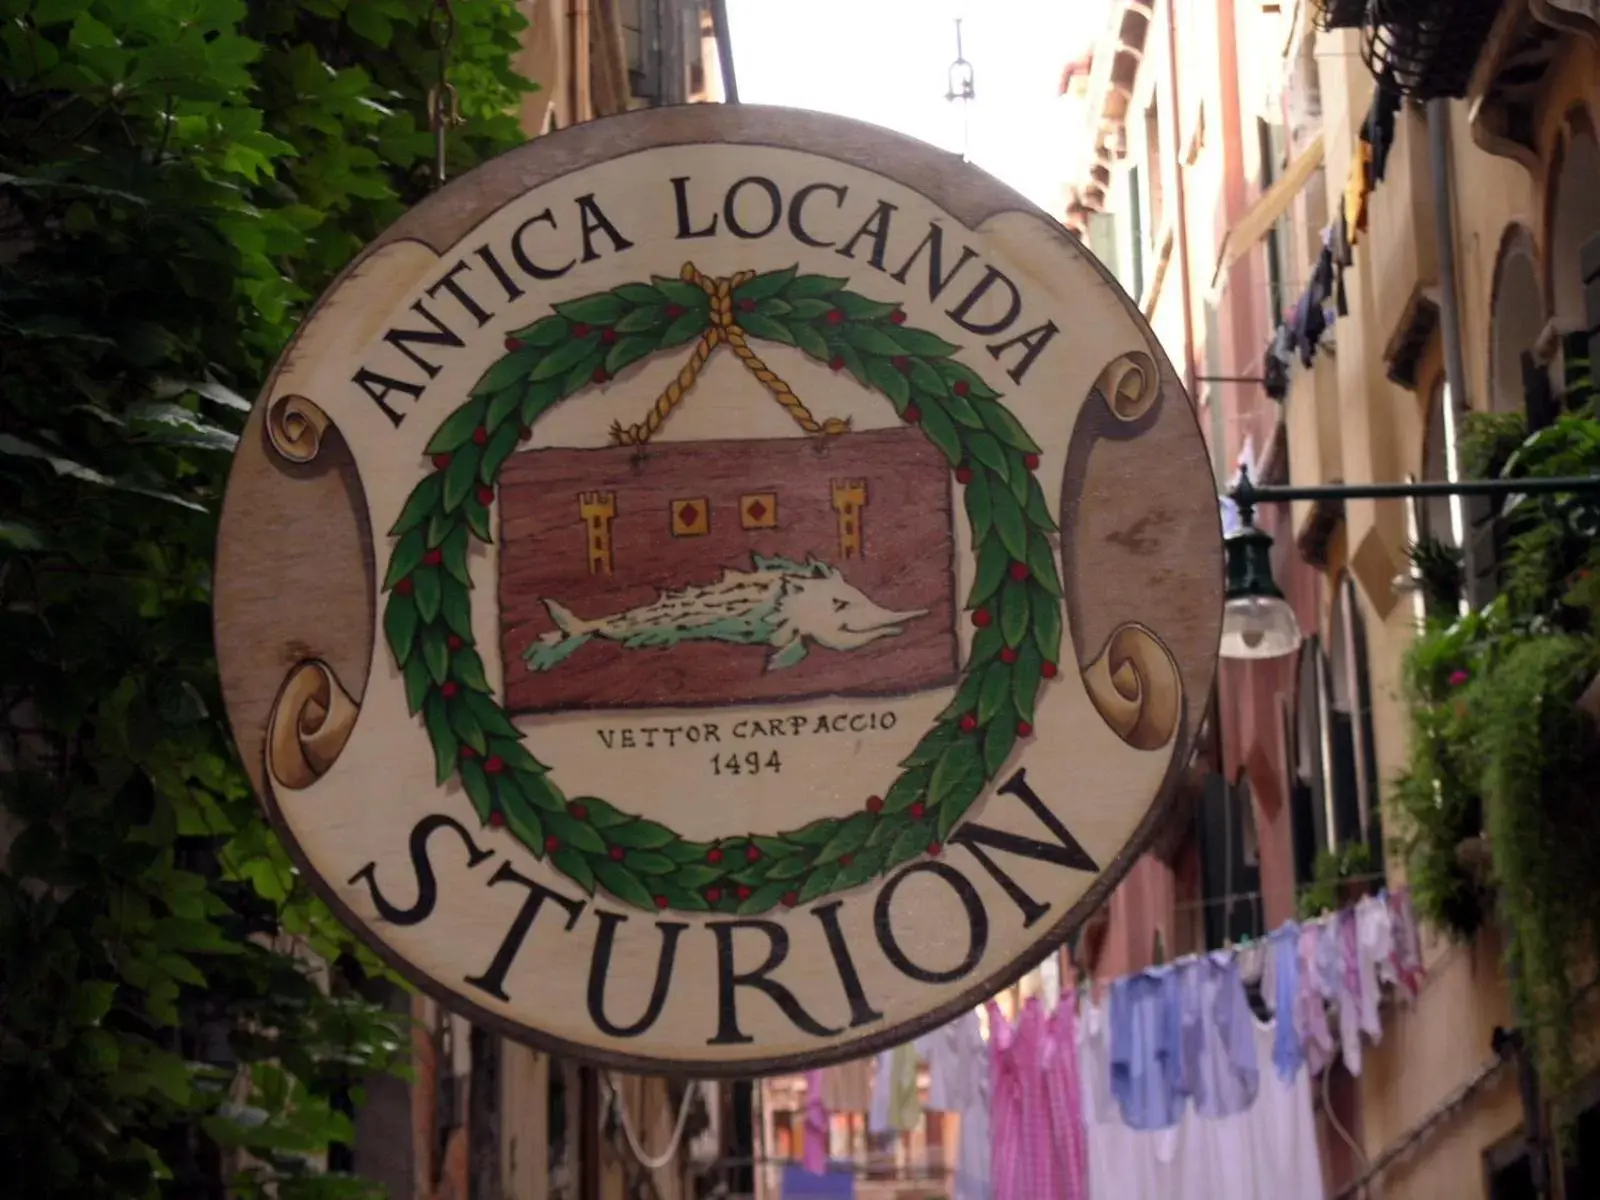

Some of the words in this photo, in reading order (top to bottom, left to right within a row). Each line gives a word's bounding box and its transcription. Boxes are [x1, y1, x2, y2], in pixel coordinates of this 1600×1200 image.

[351, 193, 634, 429] ANTICA
[669, 175, 1061, 386] LOCANDA
[597, 723, 721, 748] VETTOR
[732, 711, 897, 738] CARPACCIO
[710, 750, 782, 775] 1494
[348, 767, 1099, 1045] STURION
